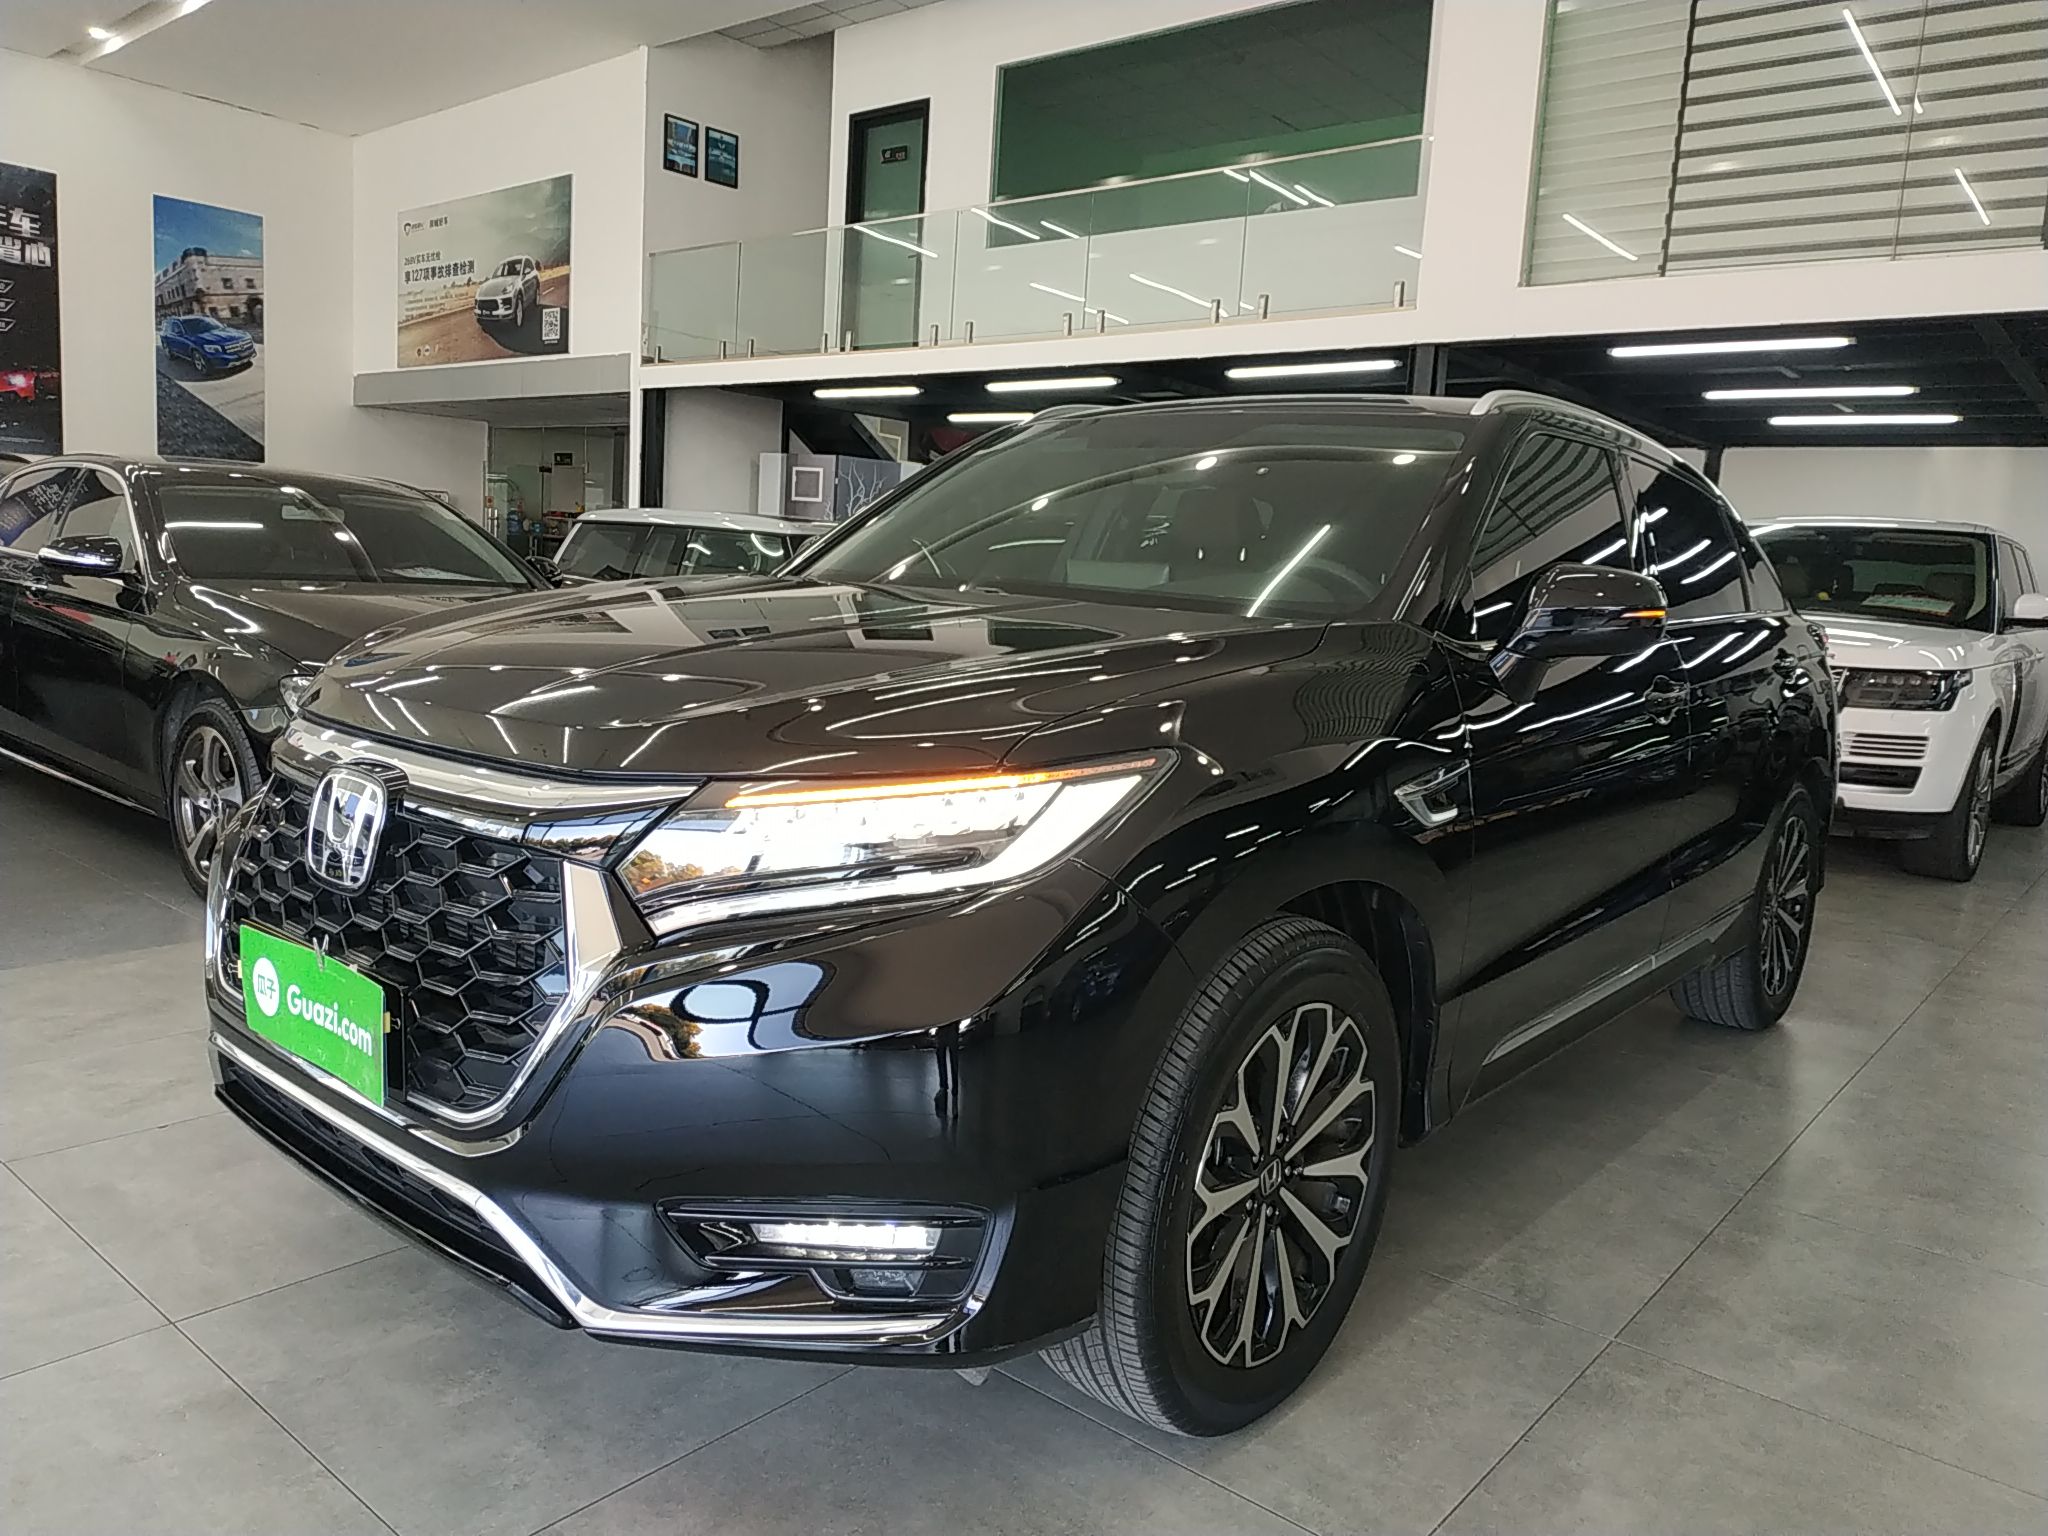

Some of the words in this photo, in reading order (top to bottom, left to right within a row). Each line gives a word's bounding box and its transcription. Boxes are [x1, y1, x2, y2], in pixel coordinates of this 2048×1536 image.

[0, 205, 40, 238] 车
[257, 973, 277, 1000] 瓜子
[286, 984, 373, 1057] Guazi.com
